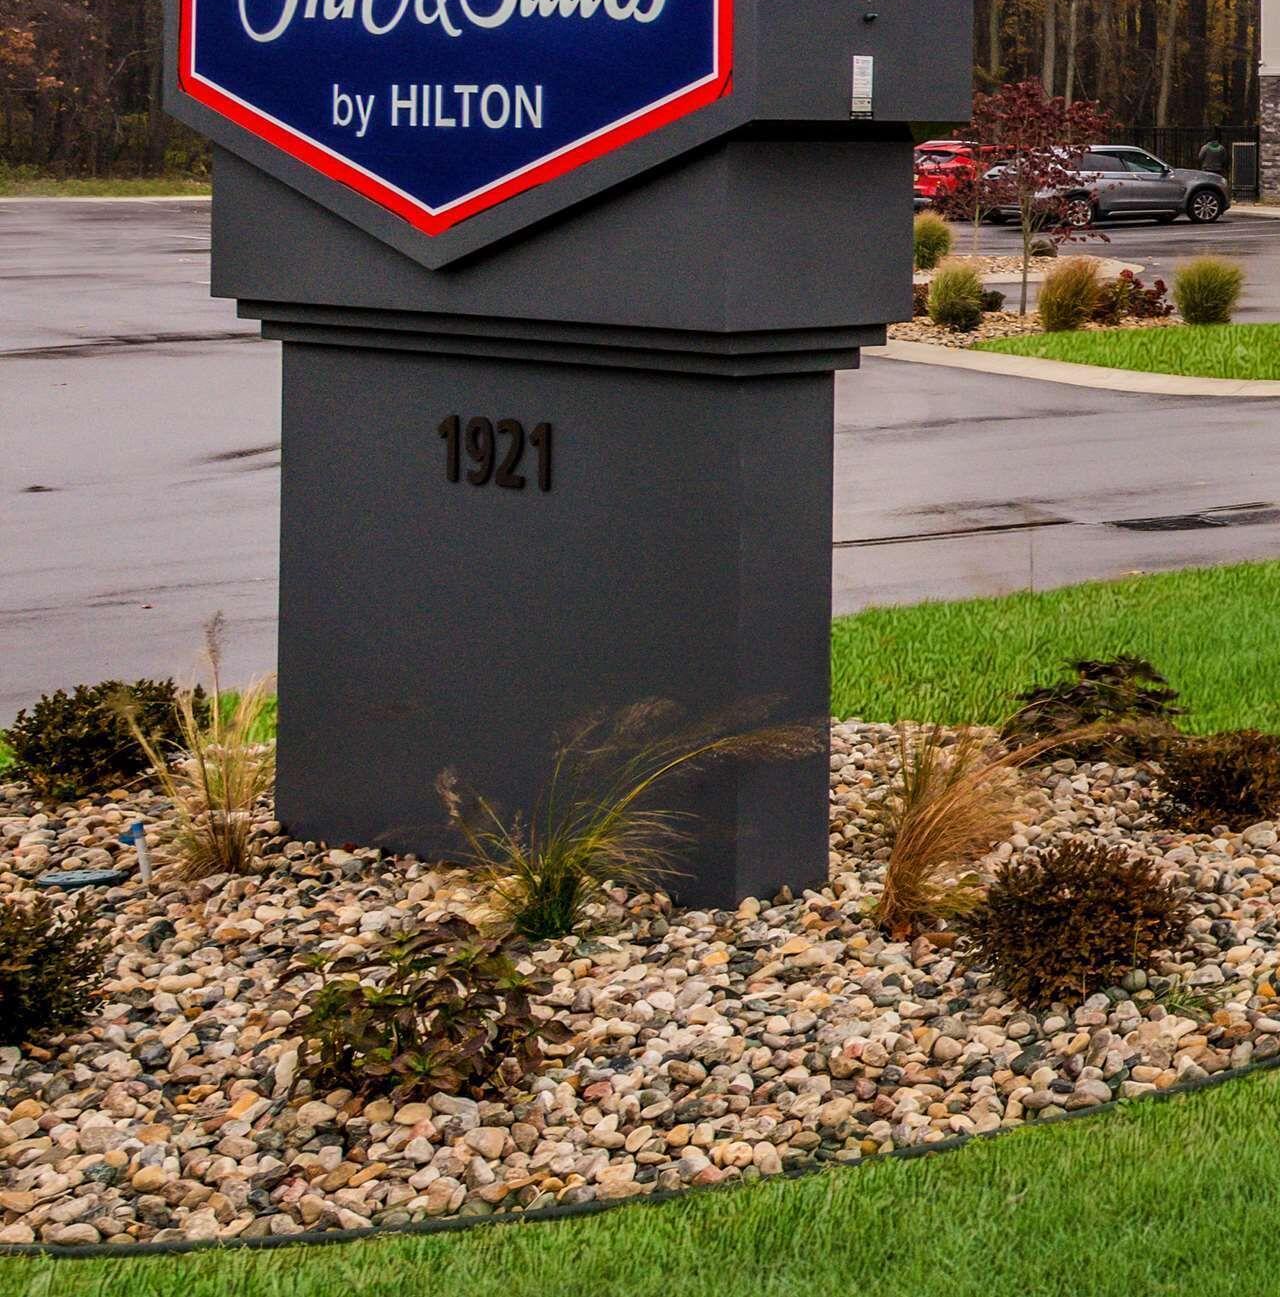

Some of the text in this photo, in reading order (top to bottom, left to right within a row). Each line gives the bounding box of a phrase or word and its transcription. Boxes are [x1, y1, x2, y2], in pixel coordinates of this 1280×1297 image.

[333, 84, 543, 137] by HILTON
[438, 415, 552, 492] 1921
